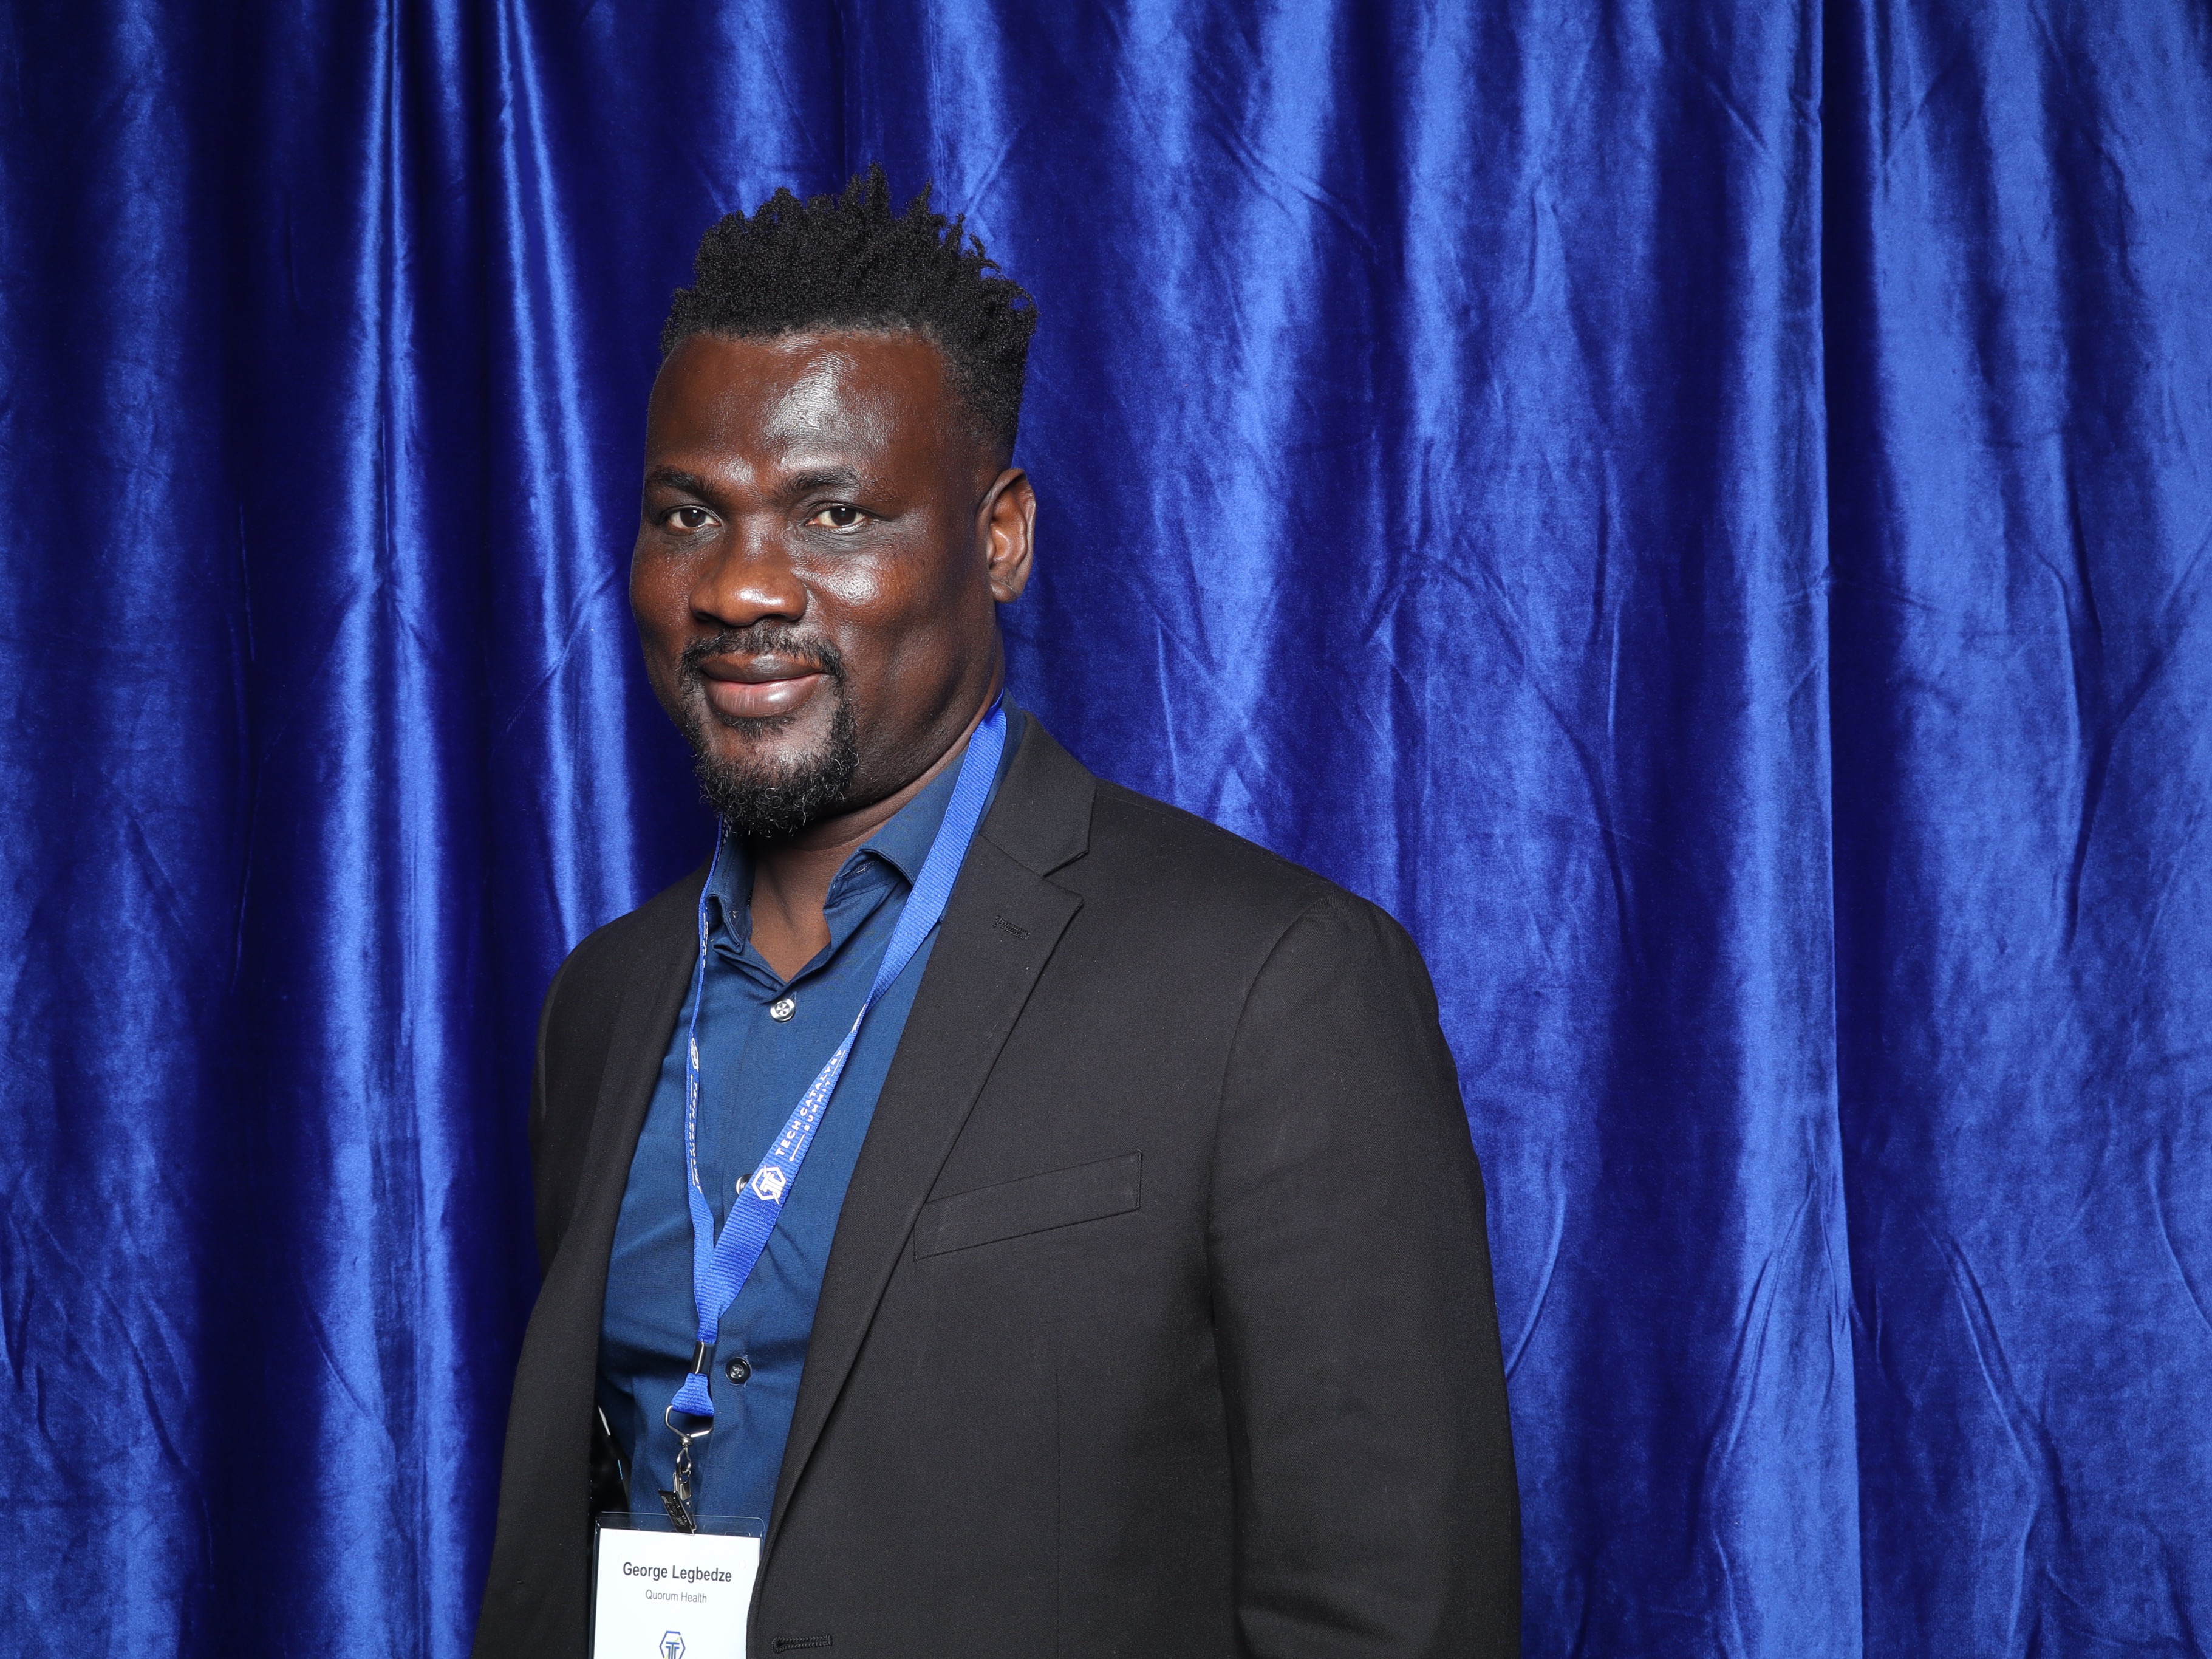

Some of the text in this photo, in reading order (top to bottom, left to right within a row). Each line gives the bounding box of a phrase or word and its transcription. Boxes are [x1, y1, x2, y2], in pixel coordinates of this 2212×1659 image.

[804, 1079, 831, 1132] SUMMIT
[774, 1120, 802, 1156] TECH
[623, 1561, 732, 1584] George Legbedze
[645, 1589, 708, 1604] Quorum Health
